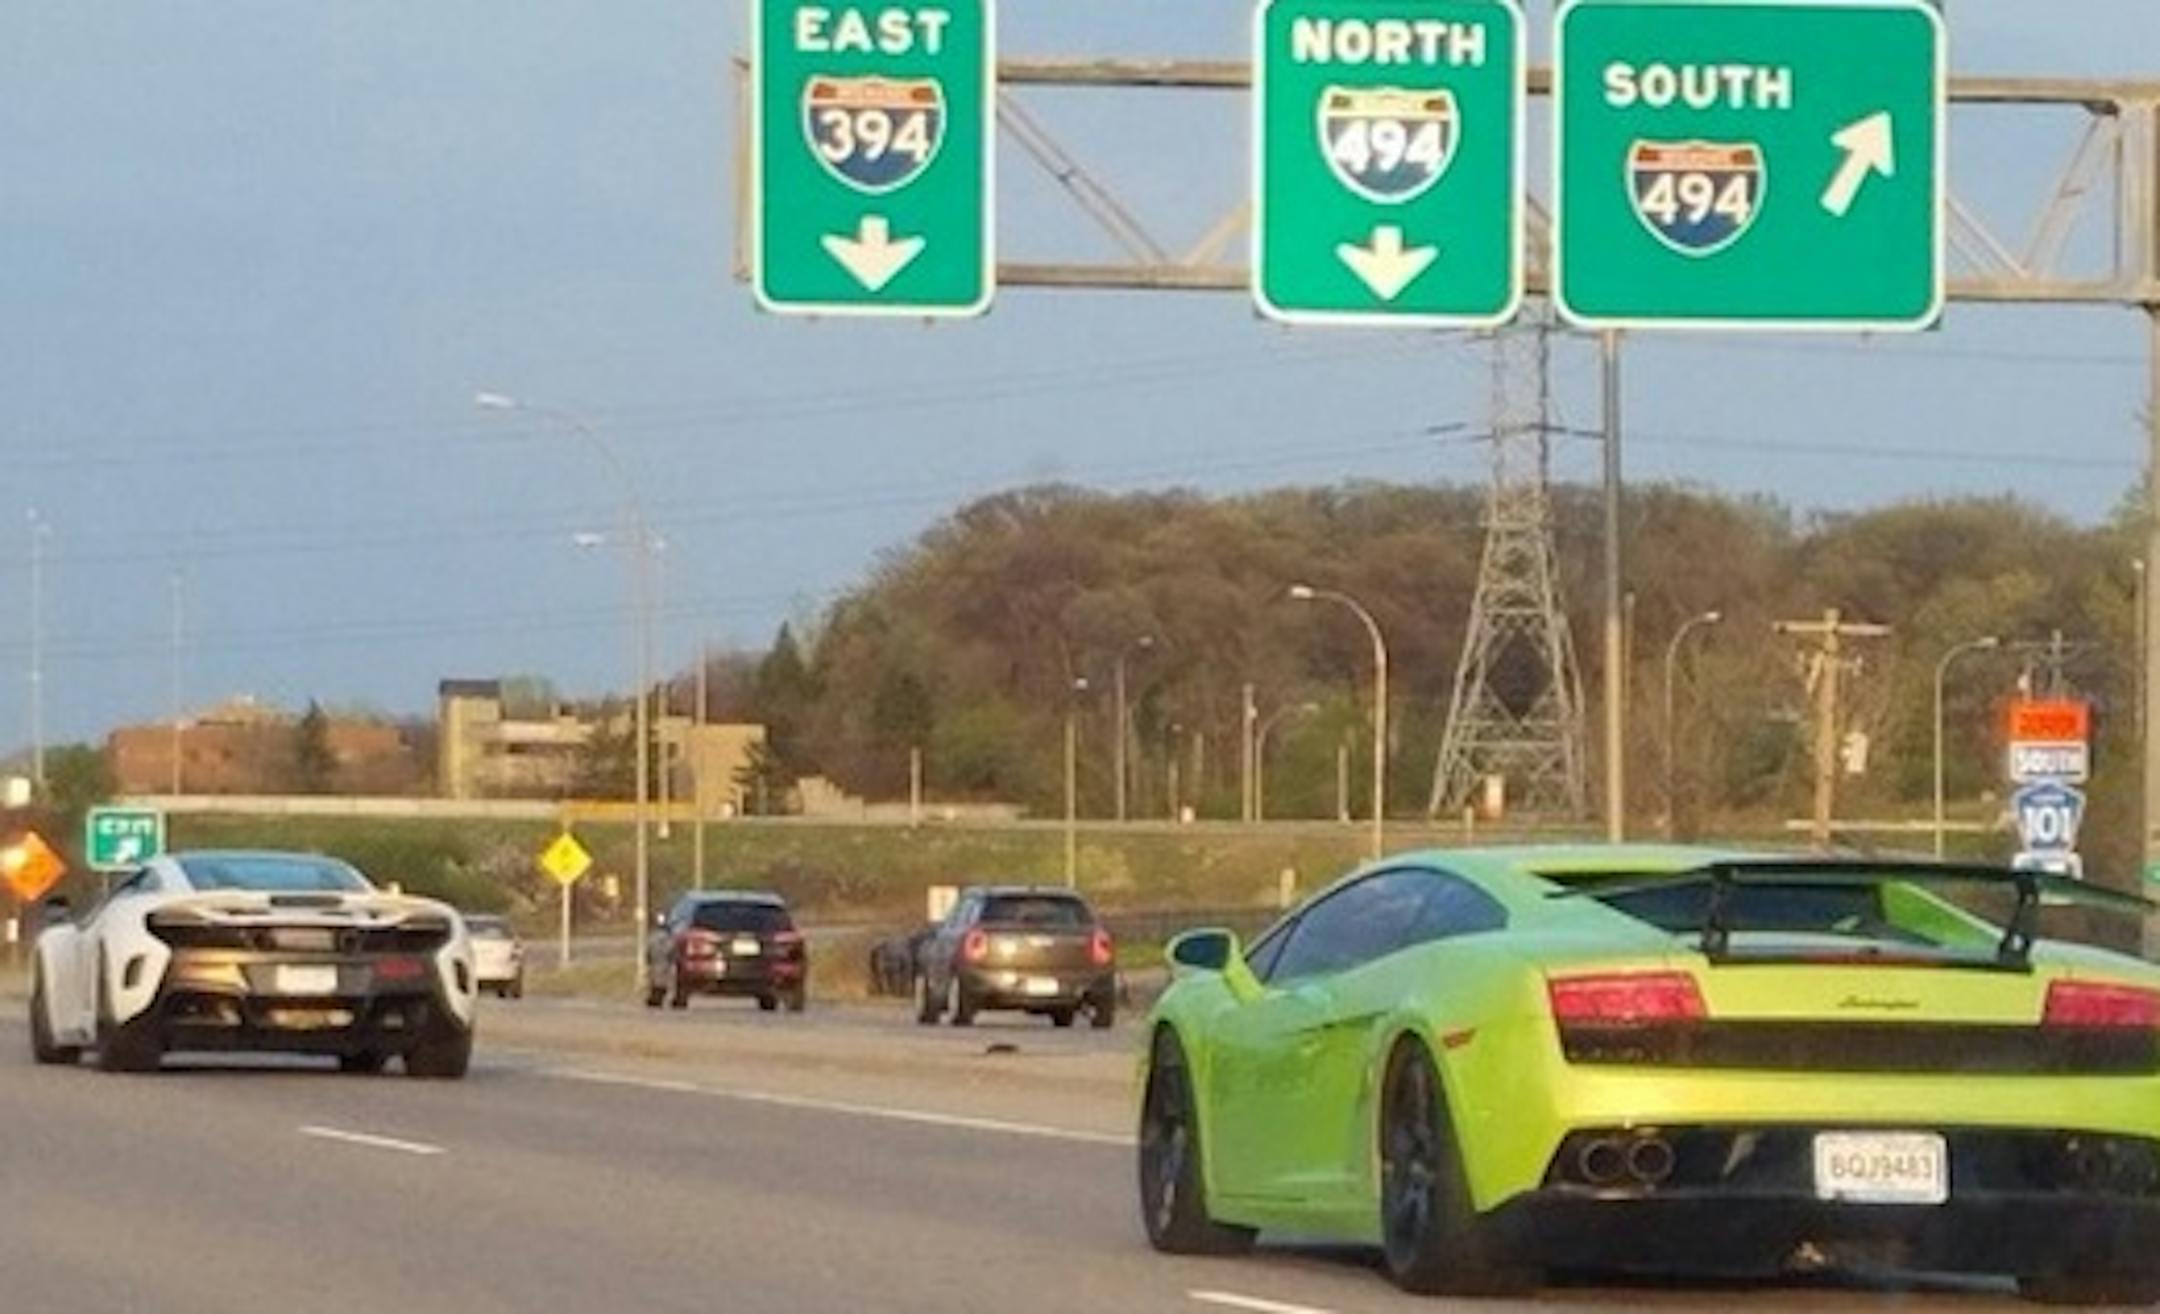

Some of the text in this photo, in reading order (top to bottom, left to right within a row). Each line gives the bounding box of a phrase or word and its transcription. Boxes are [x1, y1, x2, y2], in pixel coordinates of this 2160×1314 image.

[795, 6, 950, 54] EAST
[1292, 17, 1486, 66] NORTH
[1604, 61, 1792, 109] SOUTH
[819, 109, 931, 163] 394
[1333, 119, 1446, 173] 494
[1641, 172, 1752, 225] 494
[2022, 805, 2072, 844] 101
